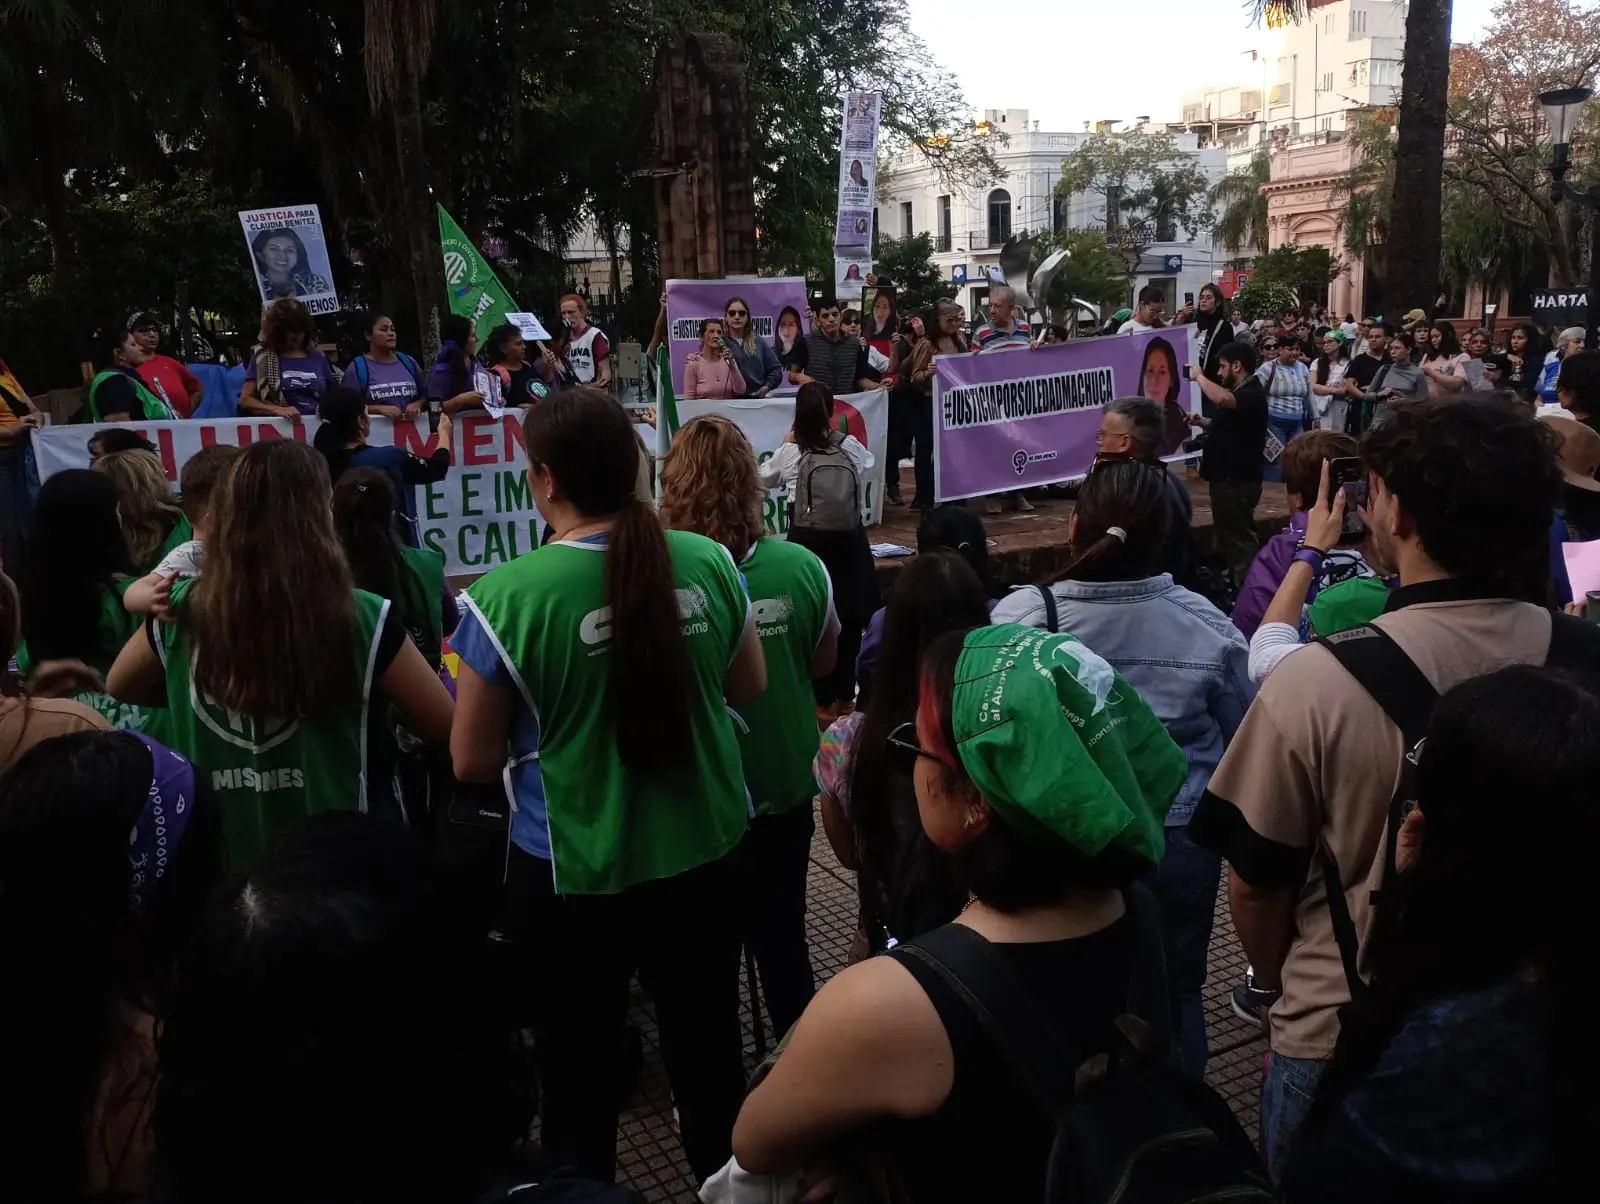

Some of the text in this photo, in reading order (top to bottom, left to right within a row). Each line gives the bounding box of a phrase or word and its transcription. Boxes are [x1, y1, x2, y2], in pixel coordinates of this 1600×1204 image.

[246, 209, 315, 223] JUSTICIA PARA
[1534, 293, 1588, 308] HARTA
[943, 369, 1114, 428] #JUSTICIAPORSOLEDADMACHUCA
